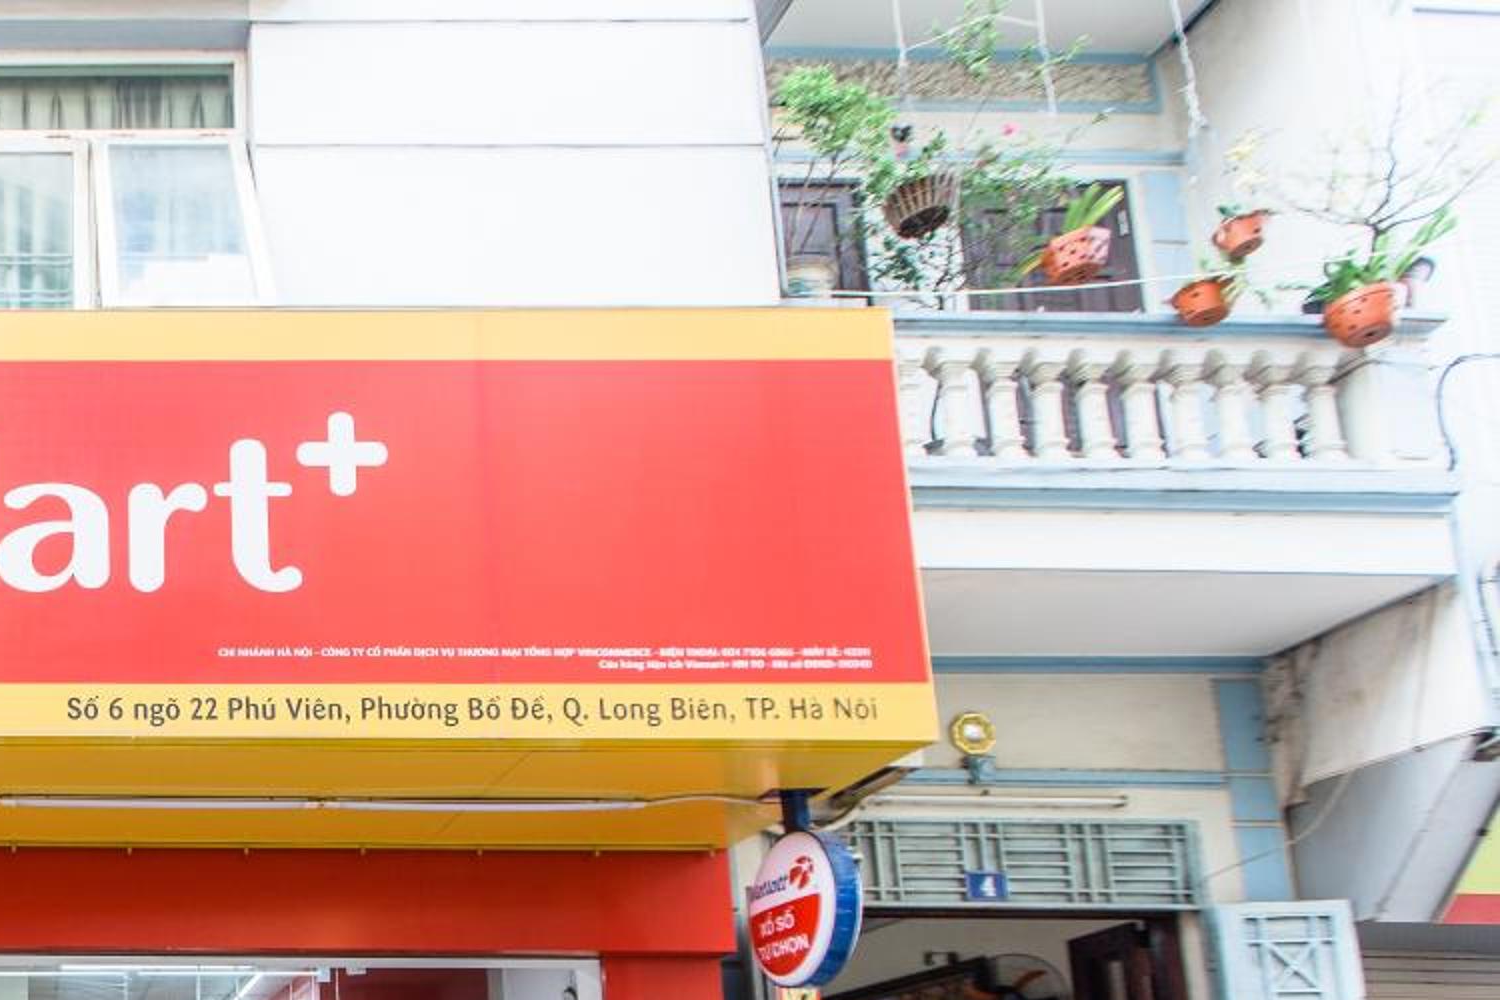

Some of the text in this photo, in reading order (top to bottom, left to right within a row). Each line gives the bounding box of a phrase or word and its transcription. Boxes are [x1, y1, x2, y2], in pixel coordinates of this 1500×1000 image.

[67, 696, 99, 720] Số
[108, 698, 123, 720] 6
[133, 698, 181, 726] ngõ
[190, 697, 218, 720] 22
[227, 697, 276, 720] Phú
[285, 697, 351, 724] Viên,
[563, 697, 589, 725] Q.
[599, 697, 661, 727] Long
[671, 697, 736, 723] Biên,
[745, 697, 779, 719] TP.
[789, 696, 823, 719] Hà
[979, 876, 997, 897] 4
